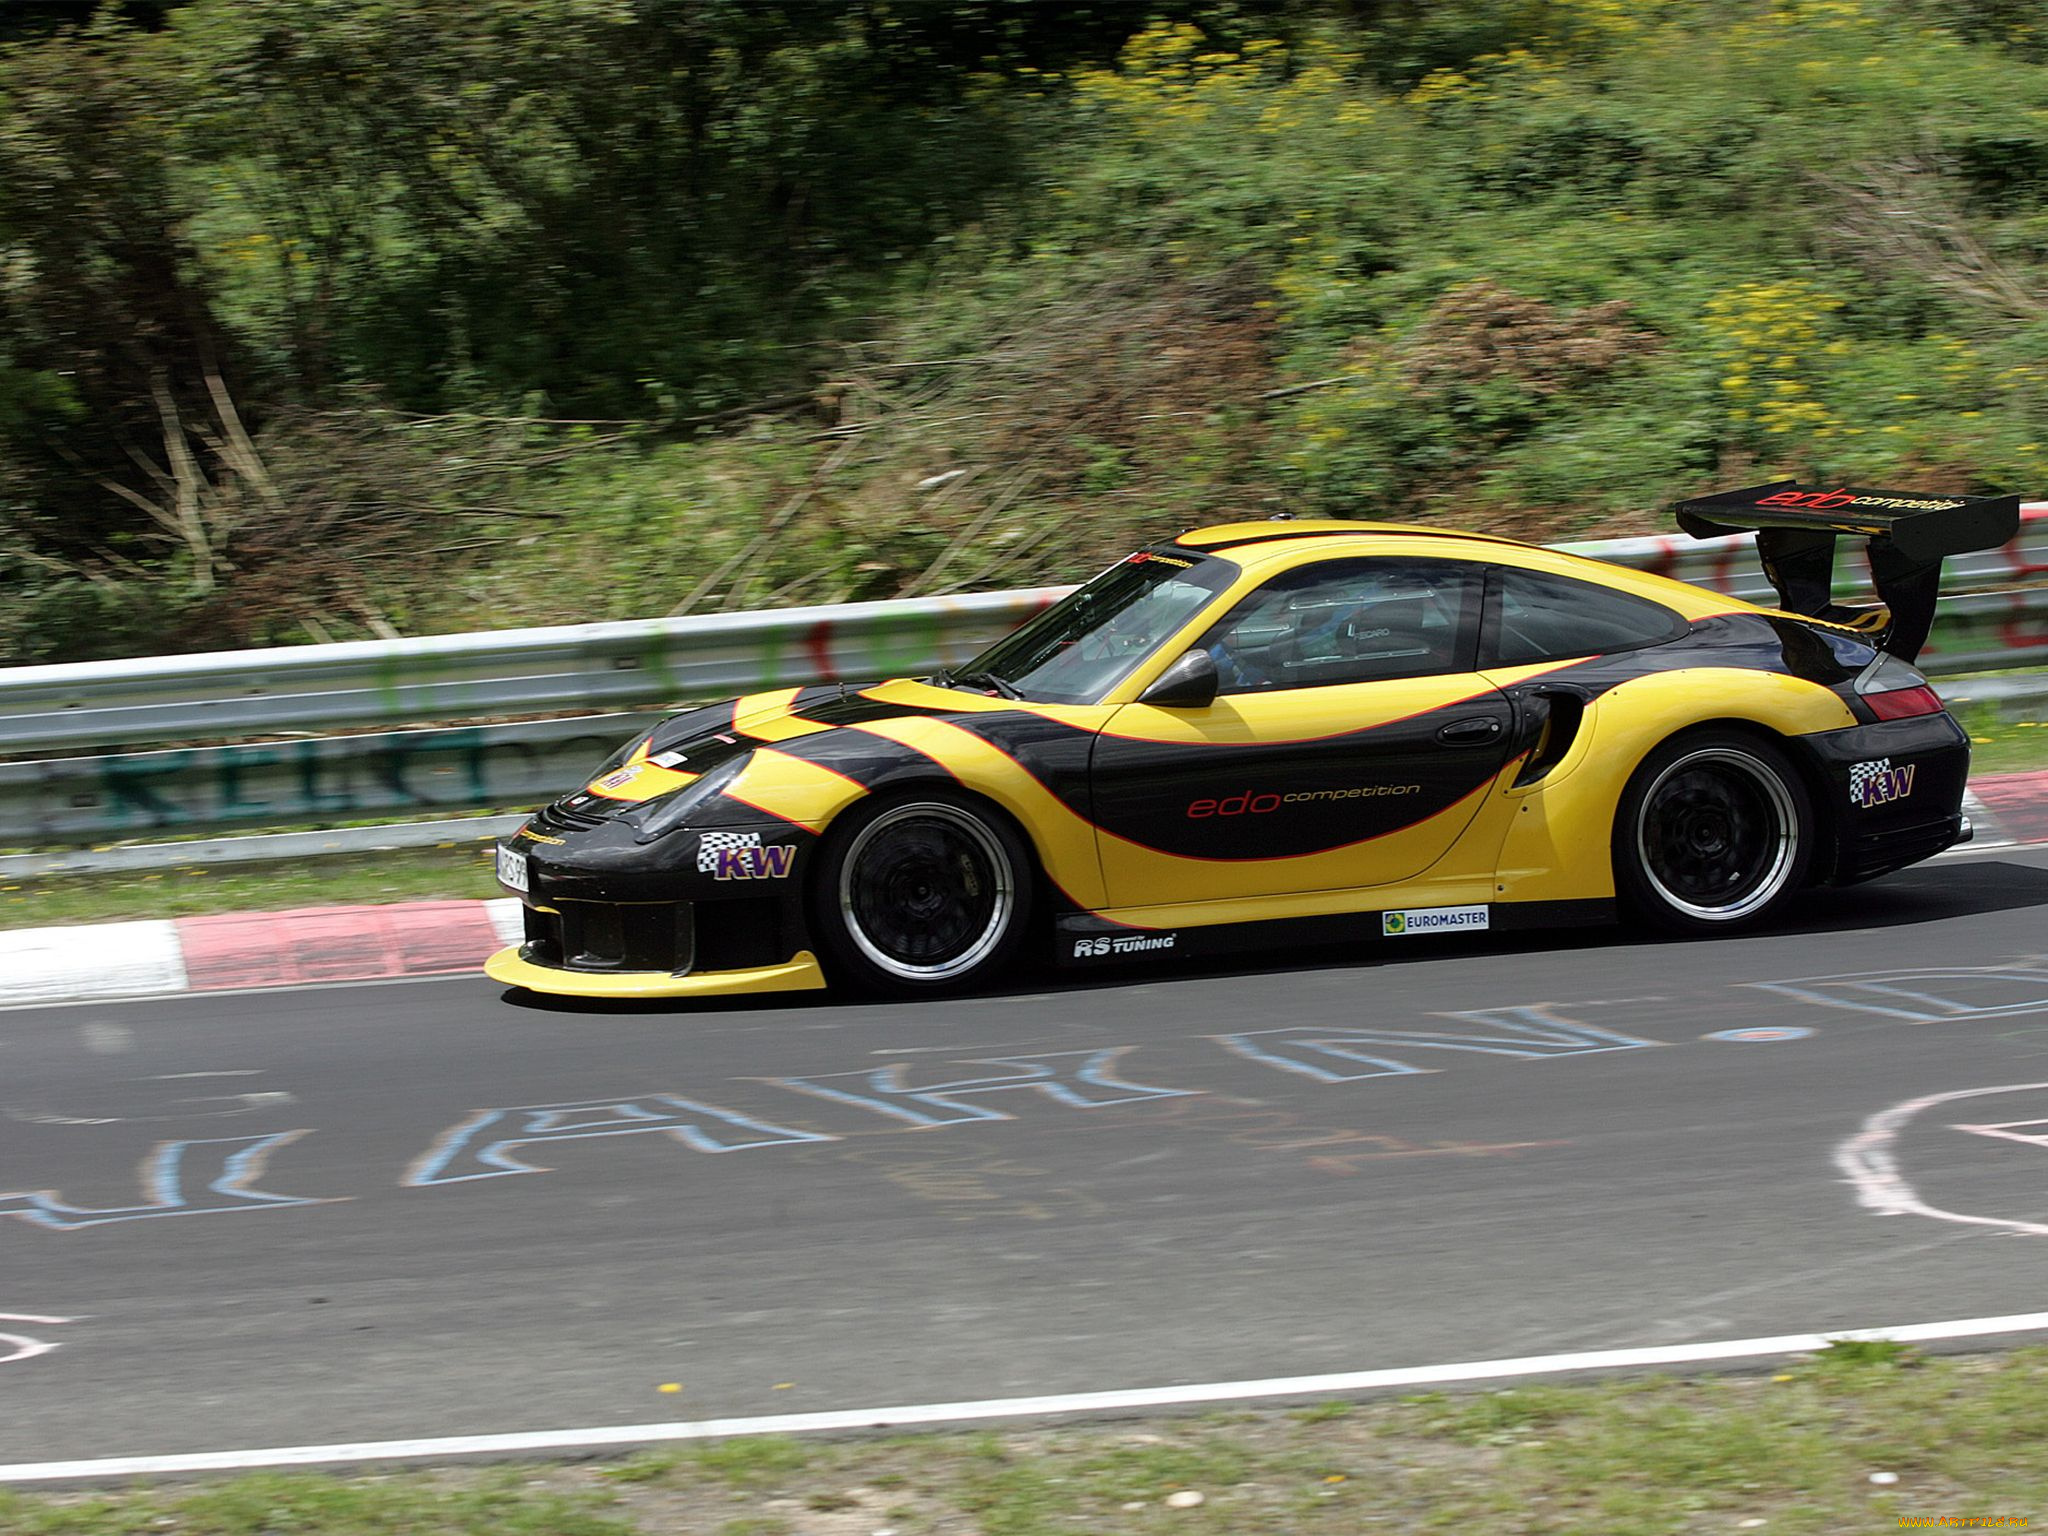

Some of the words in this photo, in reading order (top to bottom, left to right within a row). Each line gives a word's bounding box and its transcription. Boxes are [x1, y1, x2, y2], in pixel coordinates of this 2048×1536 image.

[1755, 488, 1855, 509] edo
[1861, 763, 1915, 809] KW
[1186, 789, 1281, 818] edo
[1283, 784, 1422, 803] competition
[713, 844, 798, 881] KW
[1406, 911, 1487, 928] EUROMASTER
[1073, 936, 1111, 958] RS
[1112, 936, 1175, 954] TUNING
